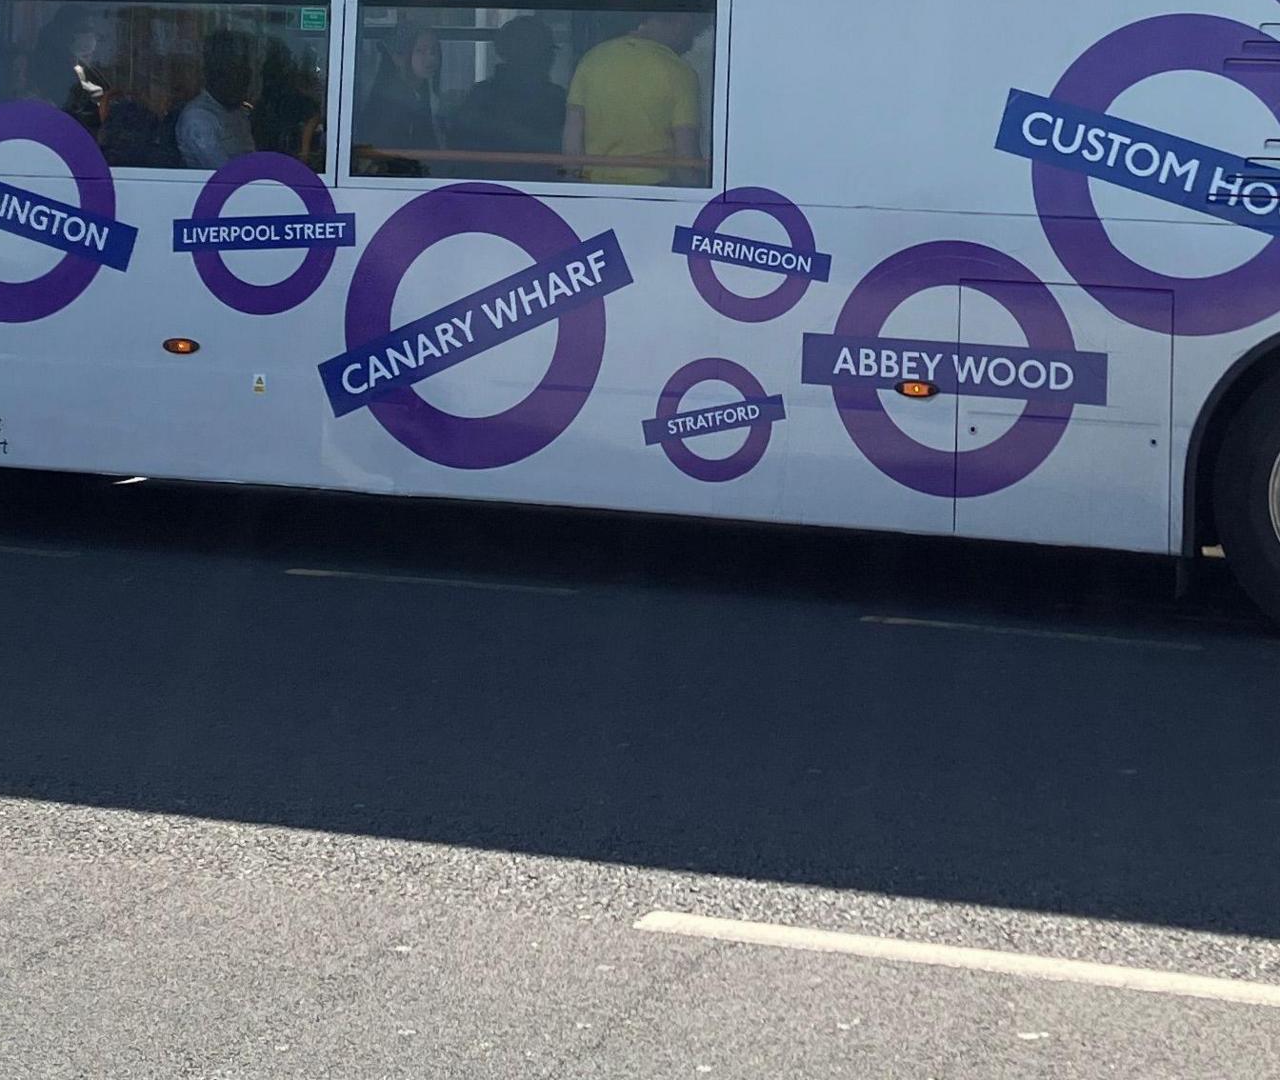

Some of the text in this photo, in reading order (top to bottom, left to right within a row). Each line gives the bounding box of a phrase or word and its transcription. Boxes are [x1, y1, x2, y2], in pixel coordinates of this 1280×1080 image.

[1022, 112, 1199, 191] CUSTOM
[182, 222, 346, 243] LIVERPOOL STREET
[691, 235, 812, 273] FARRINGDON
[342, 250, 606, 395] CANARY WHARF
[834, 347, 1074, 390] ABBEY WOOD
[667, 404, 759, 435] STRATFORD
